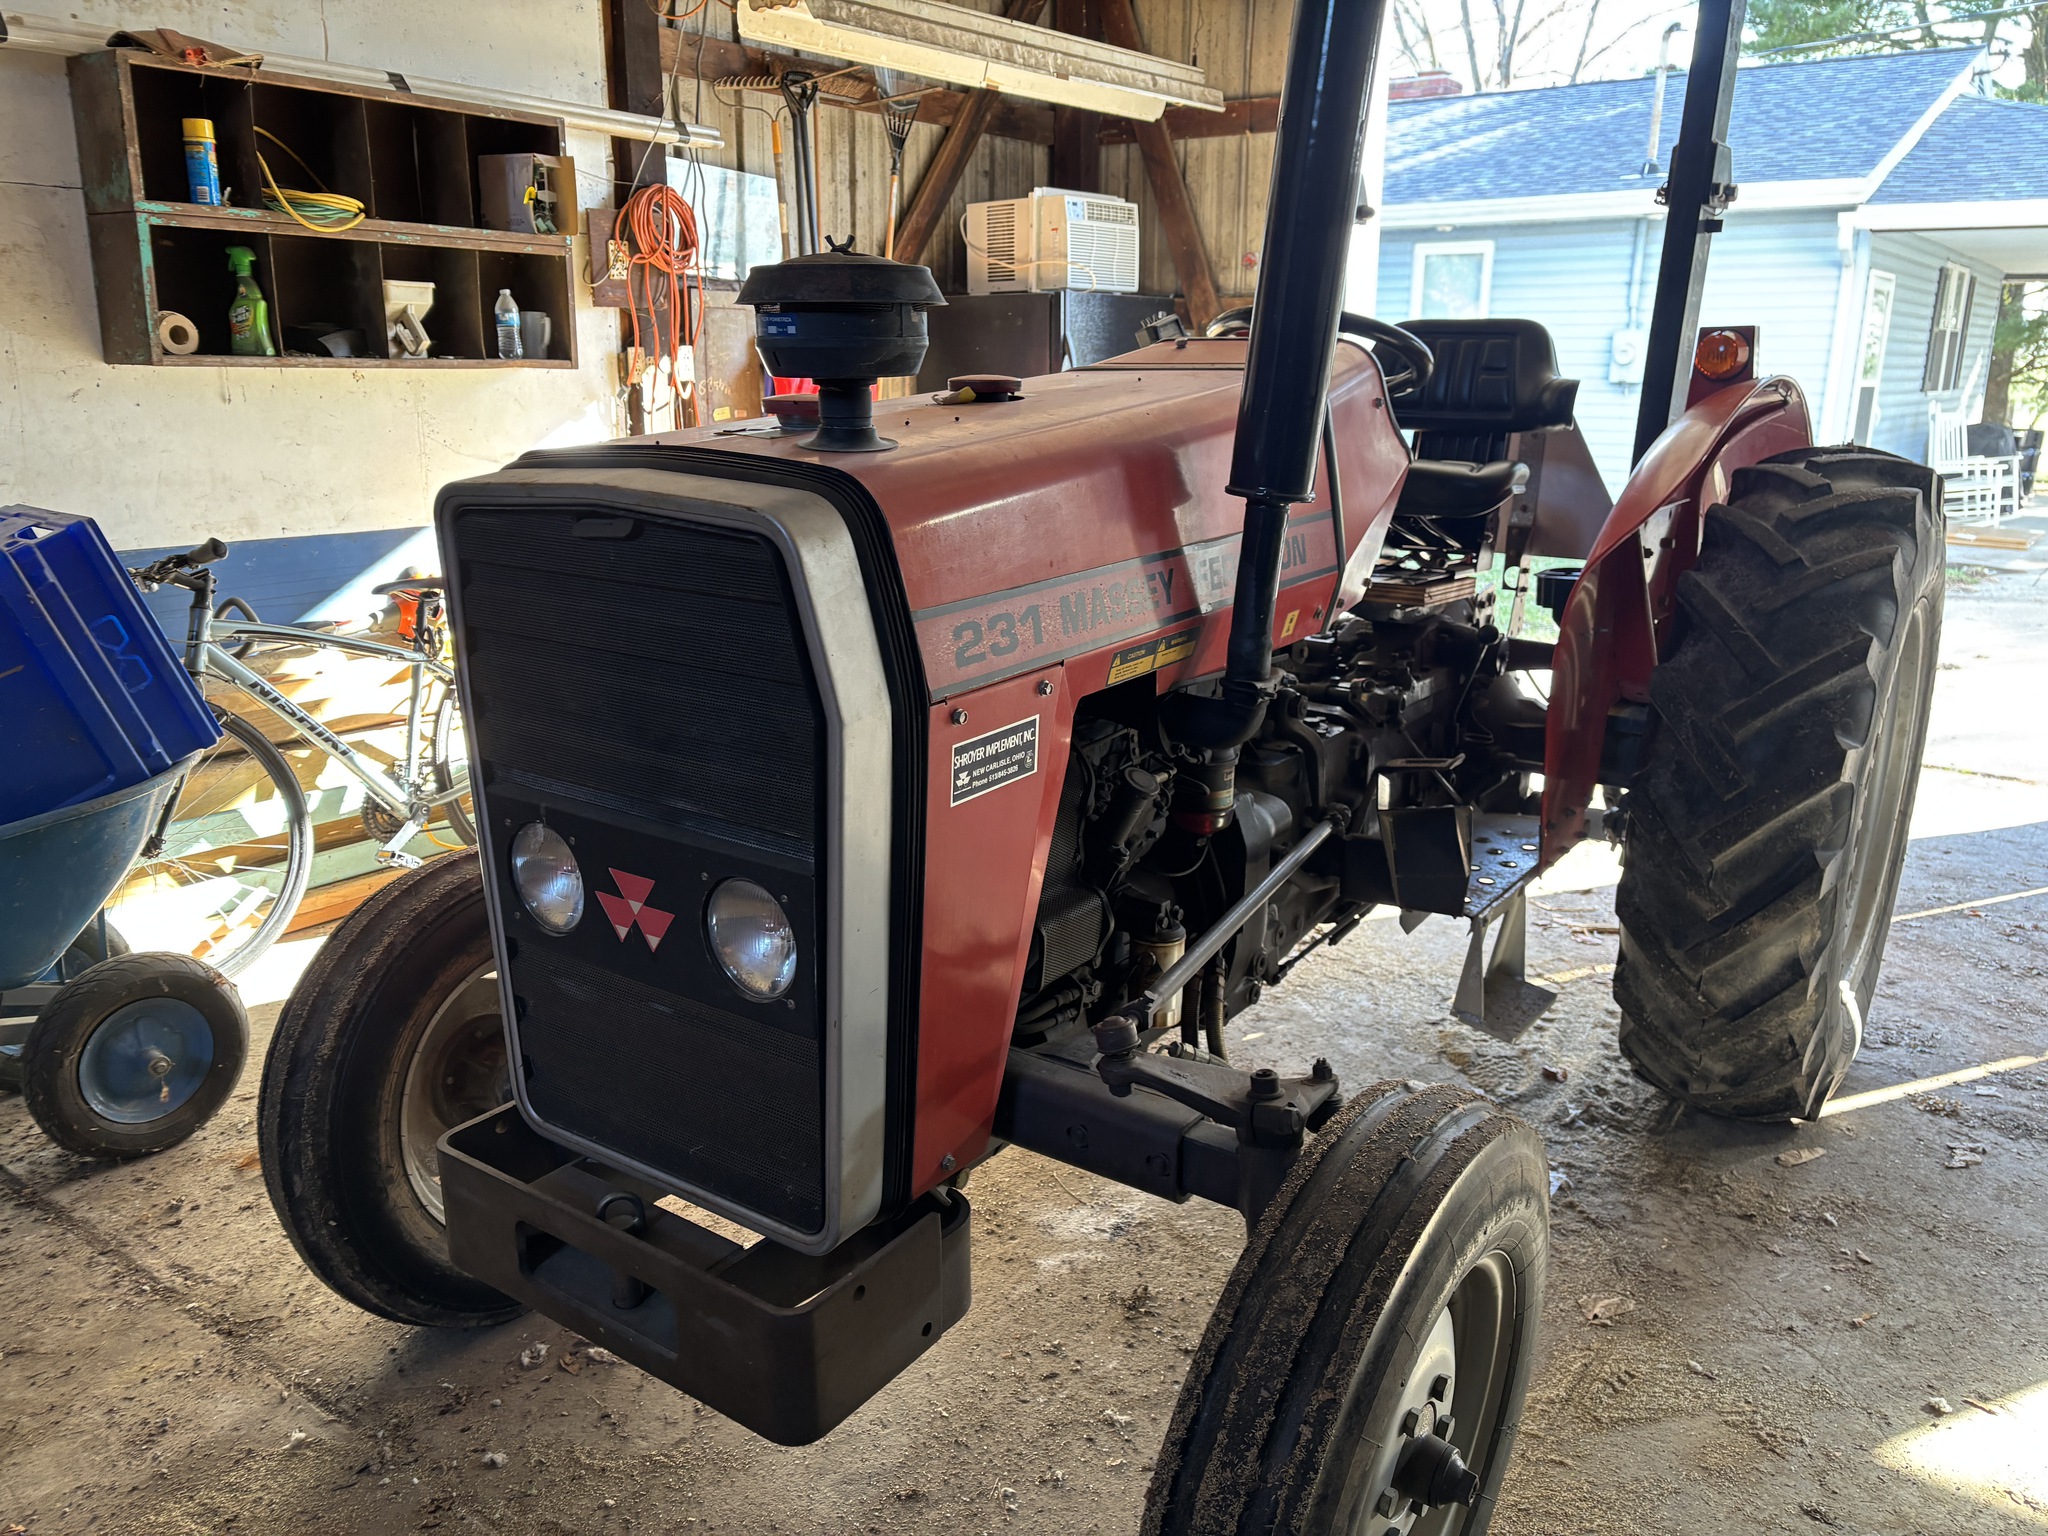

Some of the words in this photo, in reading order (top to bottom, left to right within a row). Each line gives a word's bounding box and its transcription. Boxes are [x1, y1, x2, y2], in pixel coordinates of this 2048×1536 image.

[951, 604, 1044, 669] 231
[1059, 568, 1174, 636] MASSEY
[1197, 533, 1307, 591] FERON
[1127, 649, 1146, 660] CAUTION
[954, 747, 985, 769] SHROYER
[972, 767, 985, 777] NEW
[985, 757, 1011, 772] CARLISLE,
[1011, 751, 1026, 763] OHIO
[972, 778, 988, 788] Phone
